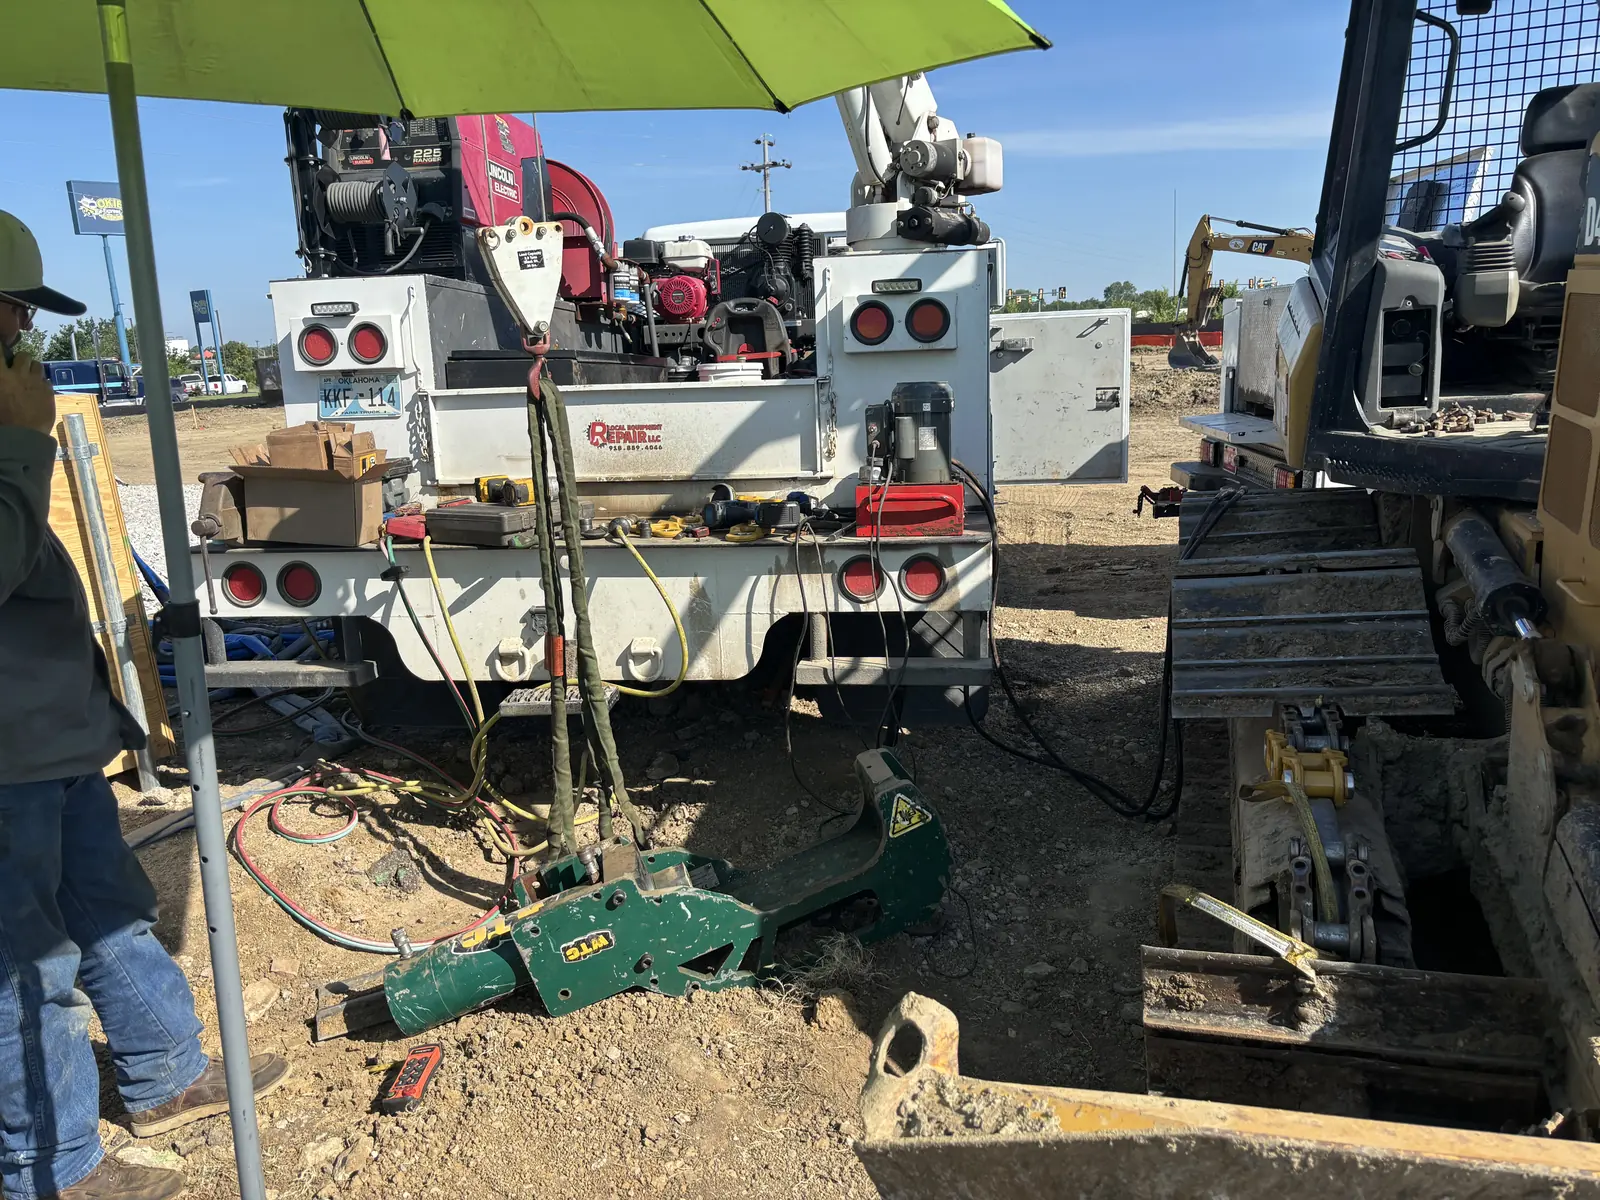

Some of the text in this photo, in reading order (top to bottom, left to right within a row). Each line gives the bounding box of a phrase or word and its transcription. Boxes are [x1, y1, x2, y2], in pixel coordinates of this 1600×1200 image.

[413, 148, 442, 158] 225
[494, 181, 518, 200] ELECTRIC
[1252, 241, 1267, 253] CAT
[338, 376, 380, 385] OKLAHOMA
[323, 386, 397, 408] KKF 114
[590, 421, 661, 446] REPAIR LLC
[565, 934, 610, 961] WTC
